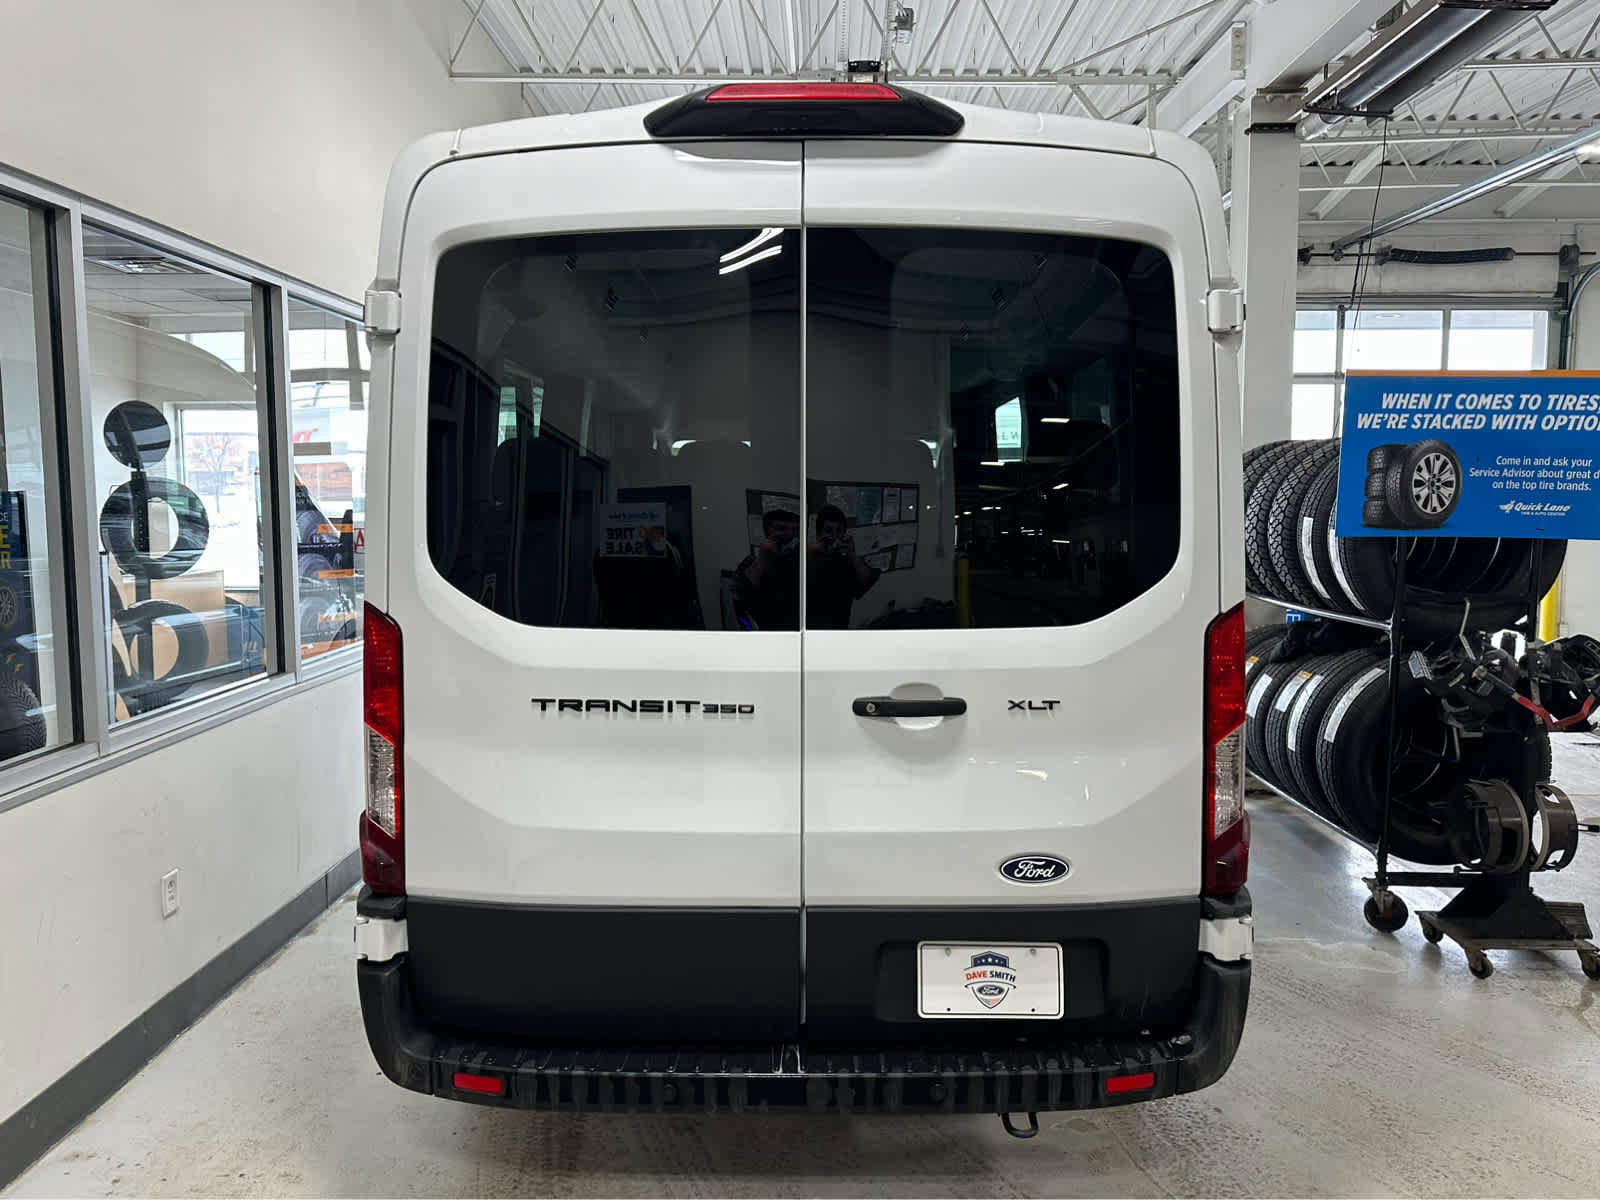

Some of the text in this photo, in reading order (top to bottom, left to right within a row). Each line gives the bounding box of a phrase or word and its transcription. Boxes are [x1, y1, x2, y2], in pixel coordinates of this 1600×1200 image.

[1382, 393, 1432, 409] WHEN
[1434, 394, 1453, 409] IT
[1455, 394, 1515, 410] COMES
[1519, 395, 1542, 410] TO
[1357, 413, 1600, 431] WE'RE STACKED WITH OPTIO
[1496, 456, 1593, 468] Come in and ask your
[1469, 468, 1500, 477] Service
[1502, 469, 1535, 478] Advisor
[1537, 469, 1564, 479] about
[1566, 470, 1591, 480] great
[1506, 480, 1520, 489] the
[1522, 481, 1537, 491] top
[1539, 482, 1555, 490] tire
[1557, 481, 1592, 491] brands.
[1514, 502, 1571, 512] Quick Lane
[531, 698, 755, 714] TRANSIT 350
[1008, 700, 1061, 710] XLT
[1014, 860, 1056, 877] Ford
[965, 970, 1016, 983] DAVE SMITH
